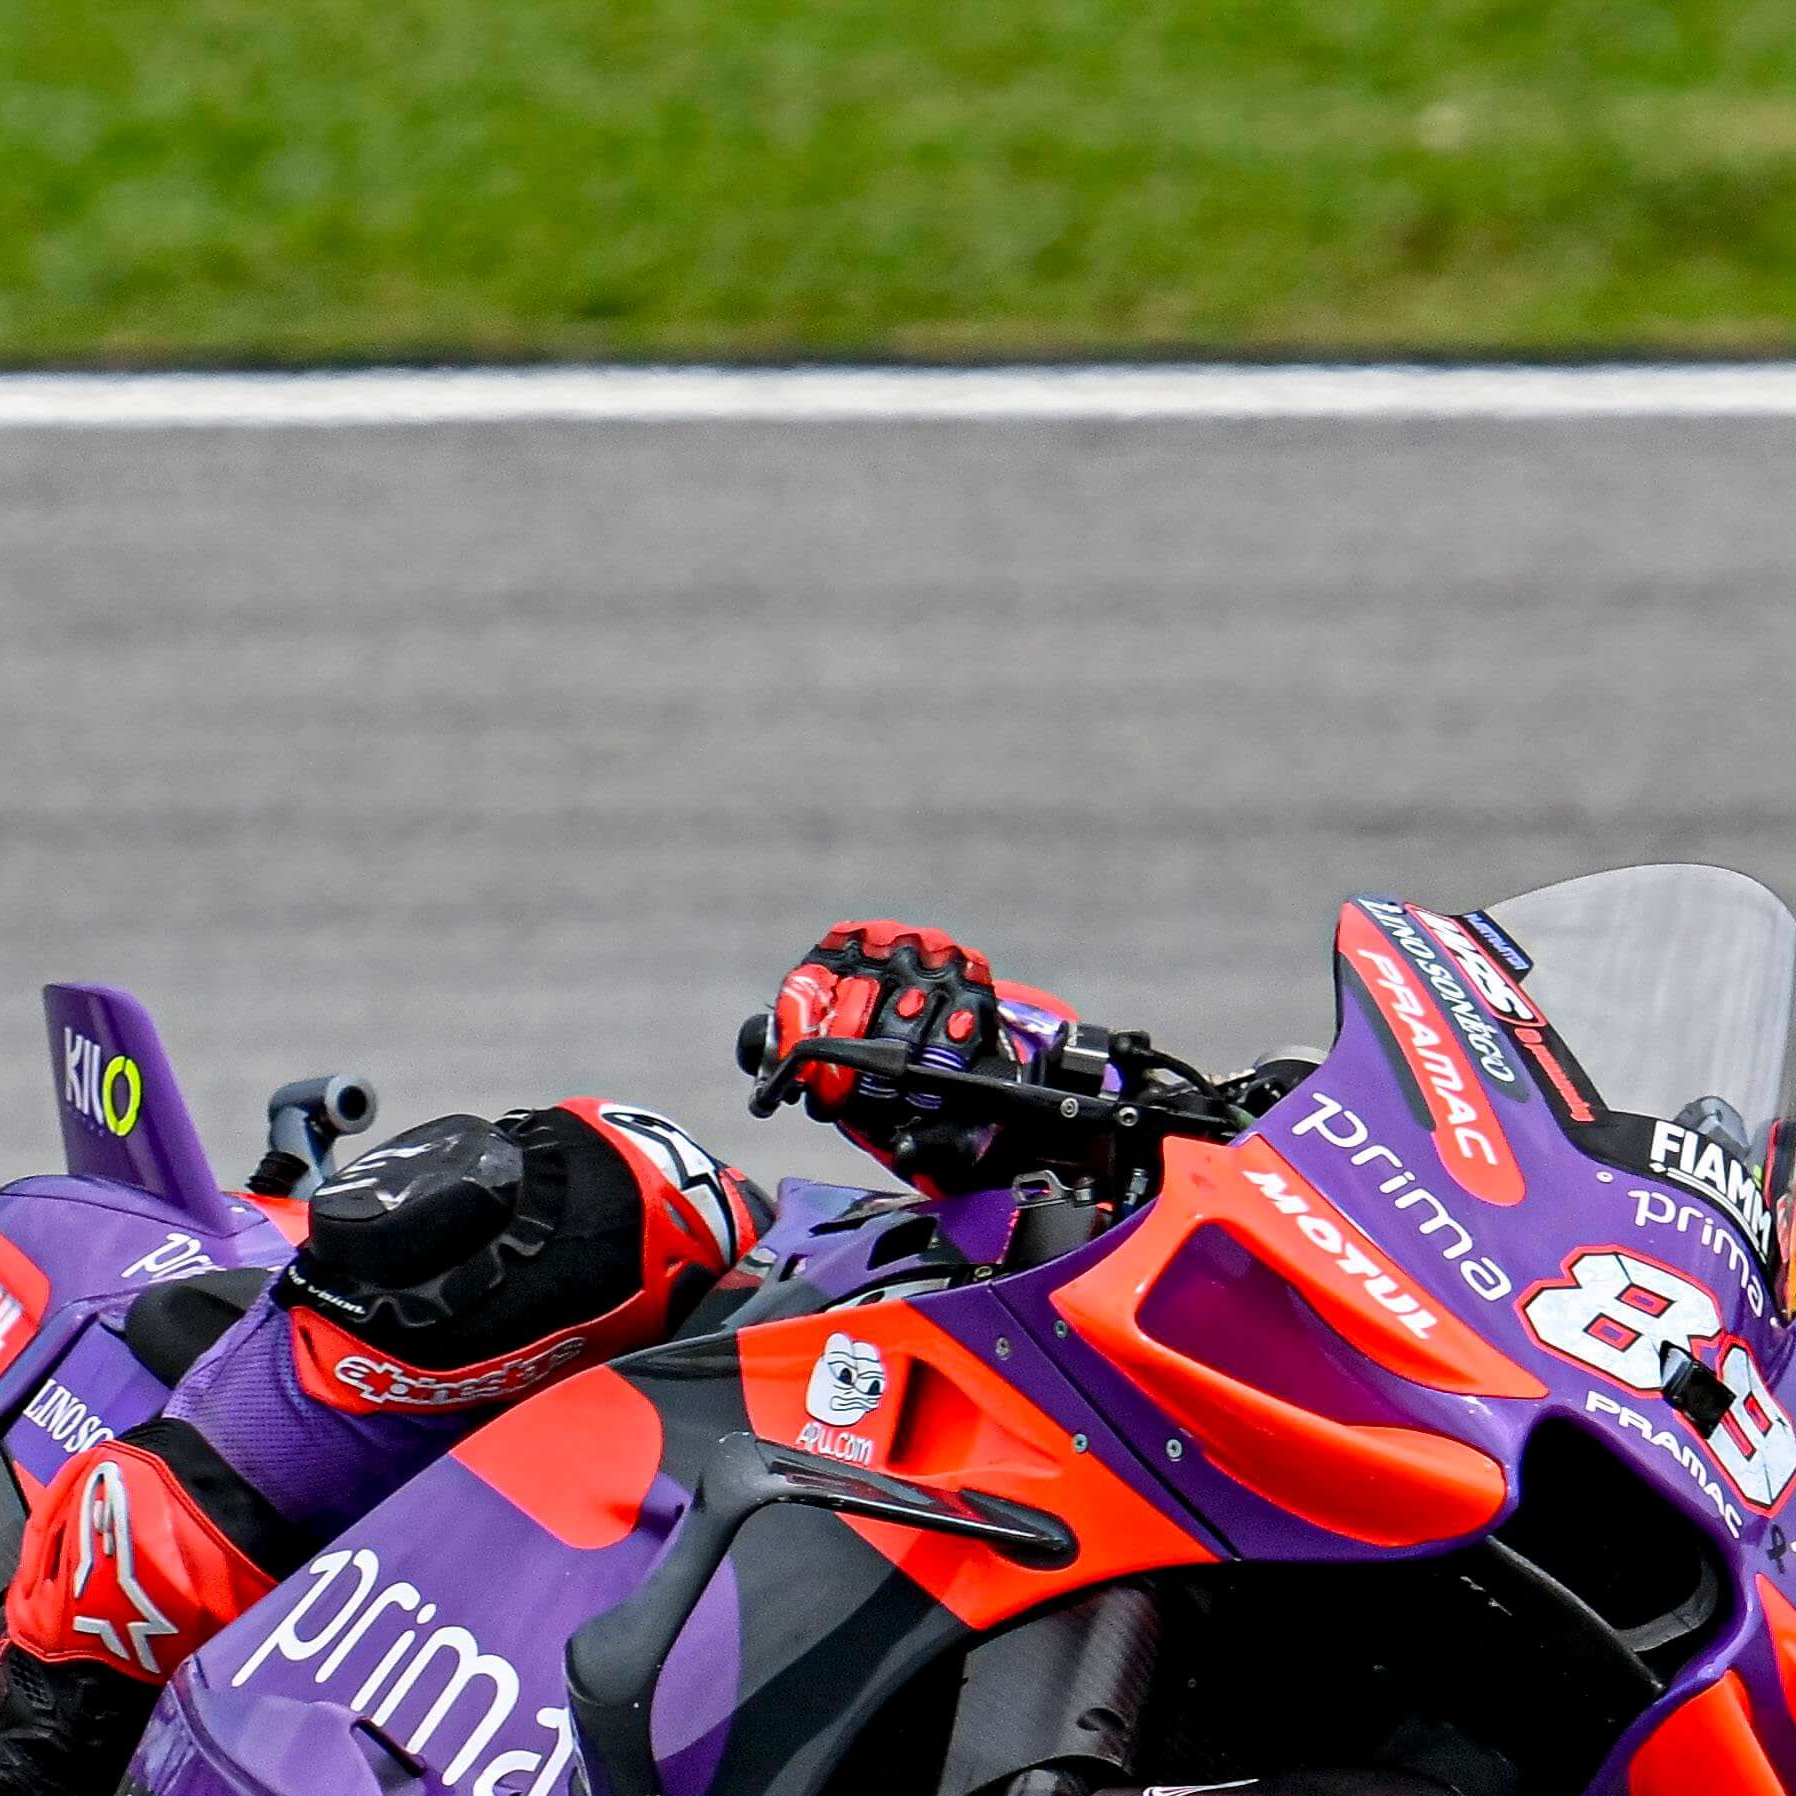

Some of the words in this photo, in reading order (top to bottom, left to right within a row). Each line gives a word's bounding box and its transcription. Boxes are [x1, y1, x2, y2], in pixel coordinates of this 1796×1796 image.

[1357, 948, 1496, 1166] PRAMAC
[1359, 898, 1435, 961] LINO
[1416, 958, 1515, 1082] SONEGO
[1243, 1167, 1439, 1340] MOTUL
[1292, 1092, 1512, 1301] prima
[1627, 1188, 1765, 1319] prima
[22, 1378, 78, 1444] LINO
[1584, 1389, 1744, 1539] PRAMAC
